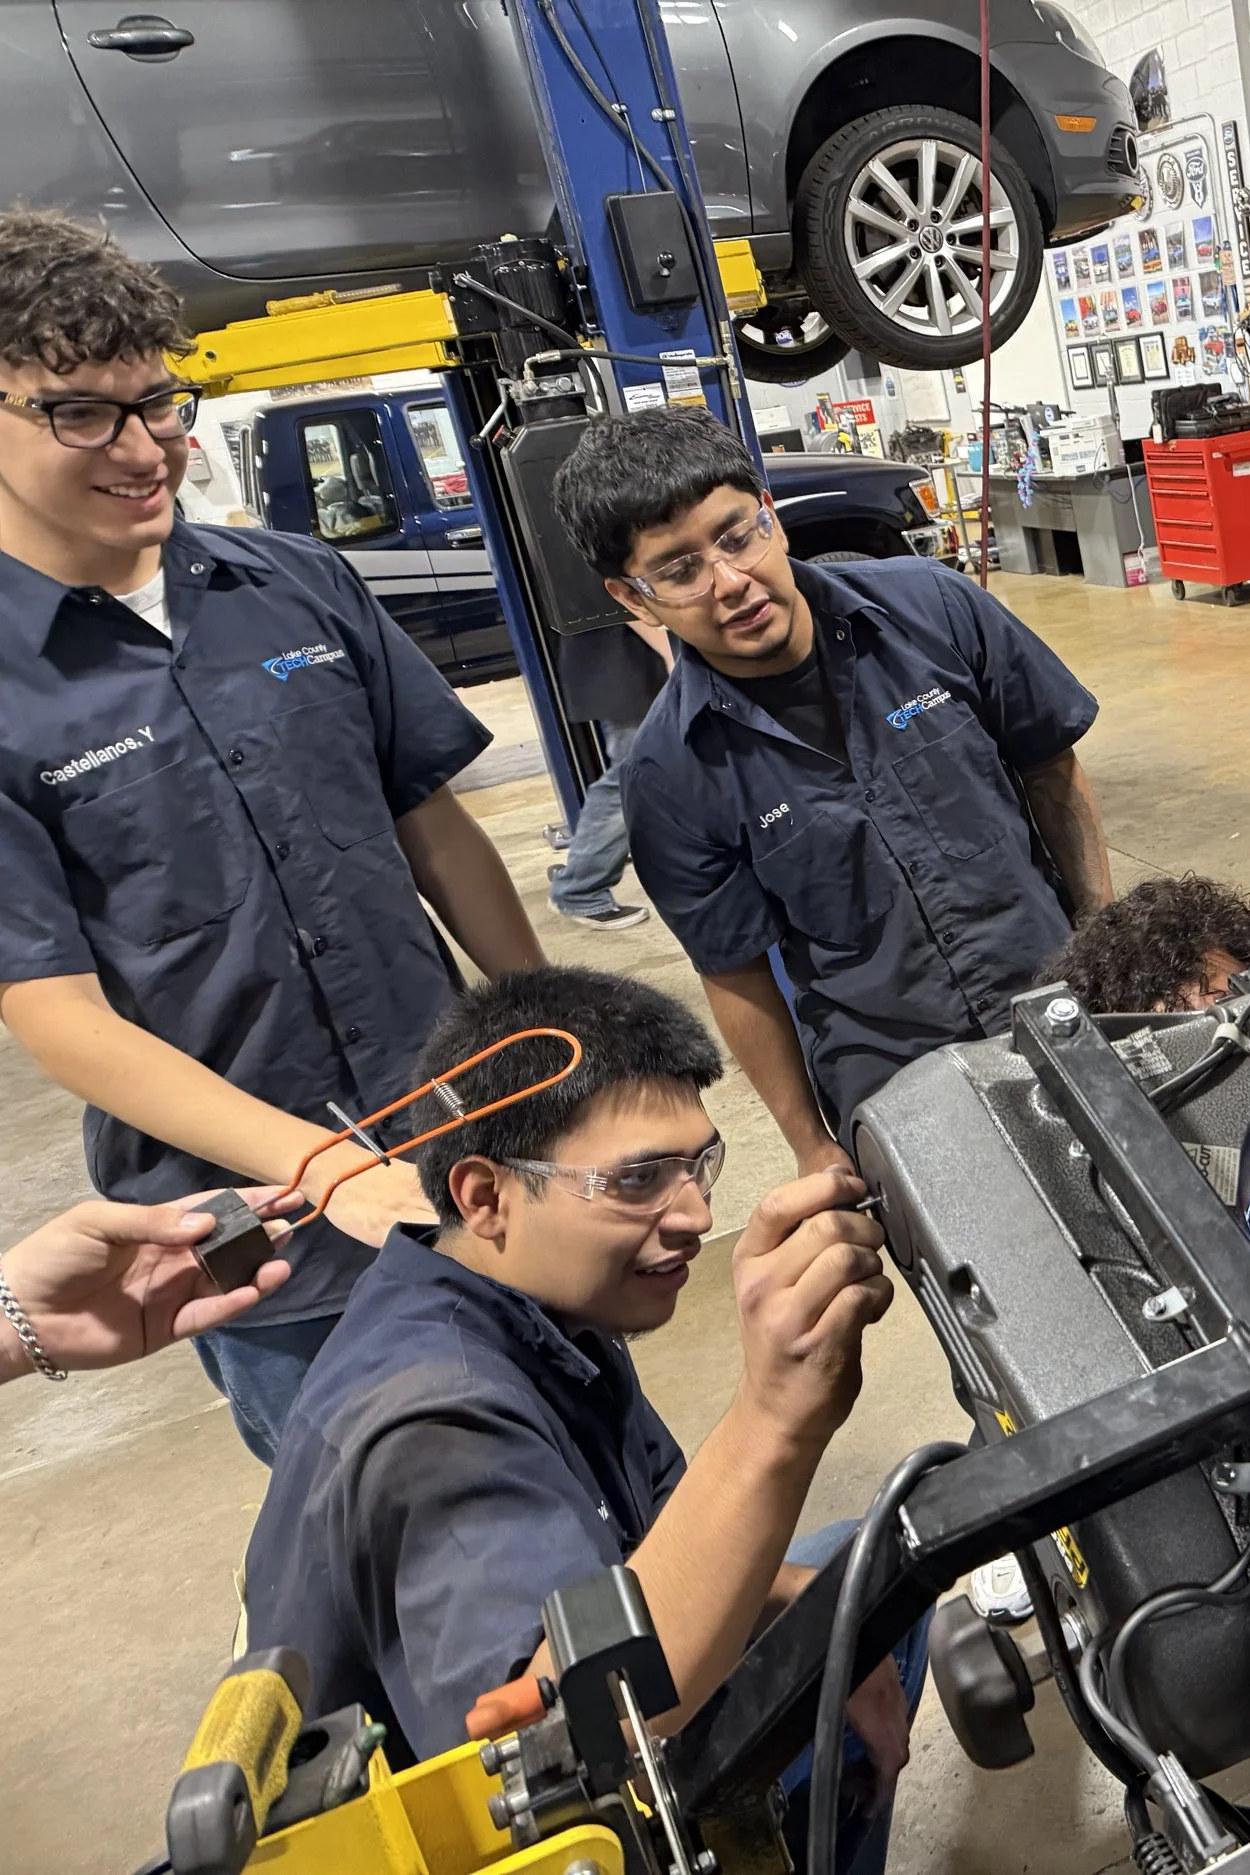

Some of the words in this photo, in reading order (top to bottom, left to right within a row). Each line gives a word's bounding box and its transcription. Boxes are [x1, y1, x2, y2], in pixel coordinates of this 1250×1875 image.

[282, 650, 301, 660] Lake
[301, 643, 327, 655] County
[137, 725, 154, 742] Y
[760, 803, 790, 828] Jose
